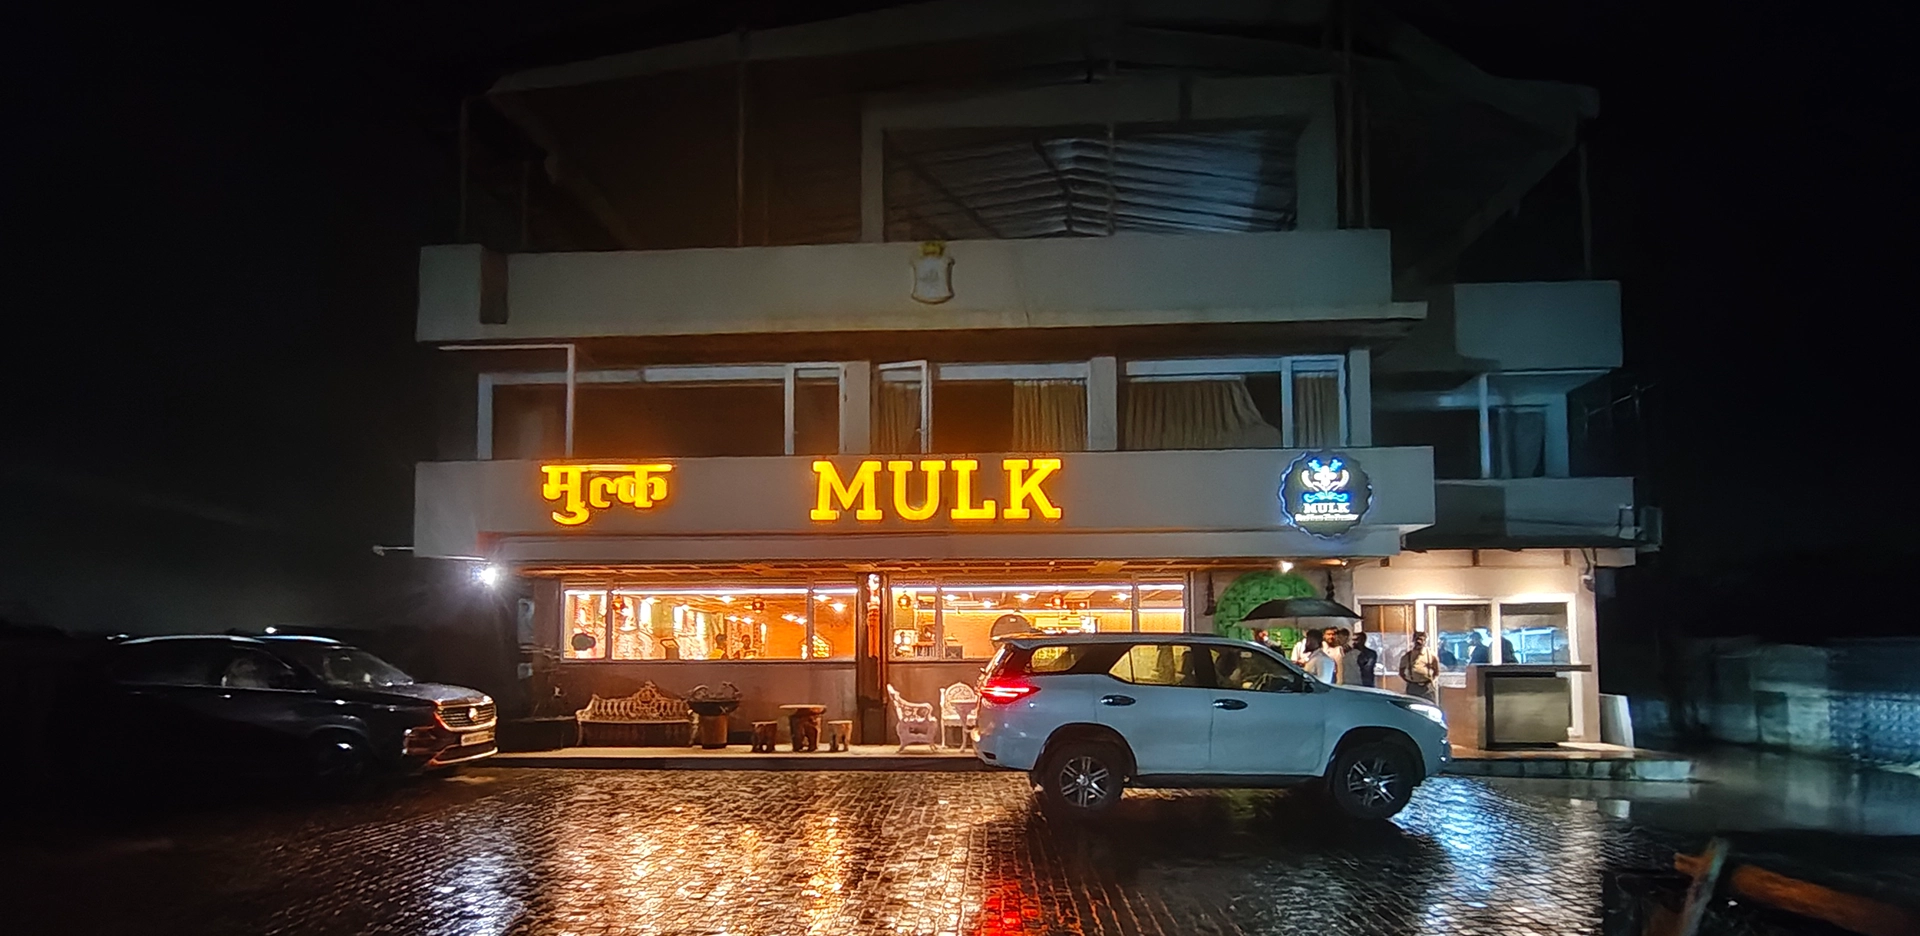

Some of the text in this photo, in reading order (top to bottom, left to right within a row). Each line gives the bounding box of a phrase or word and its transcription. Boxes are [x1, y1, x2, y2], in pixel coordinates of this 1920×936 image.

[541, 464, 673, 525] मुल्क
[810, 459, 1063, 521] MULK
[1303, 503, 1350, 513] MULK
